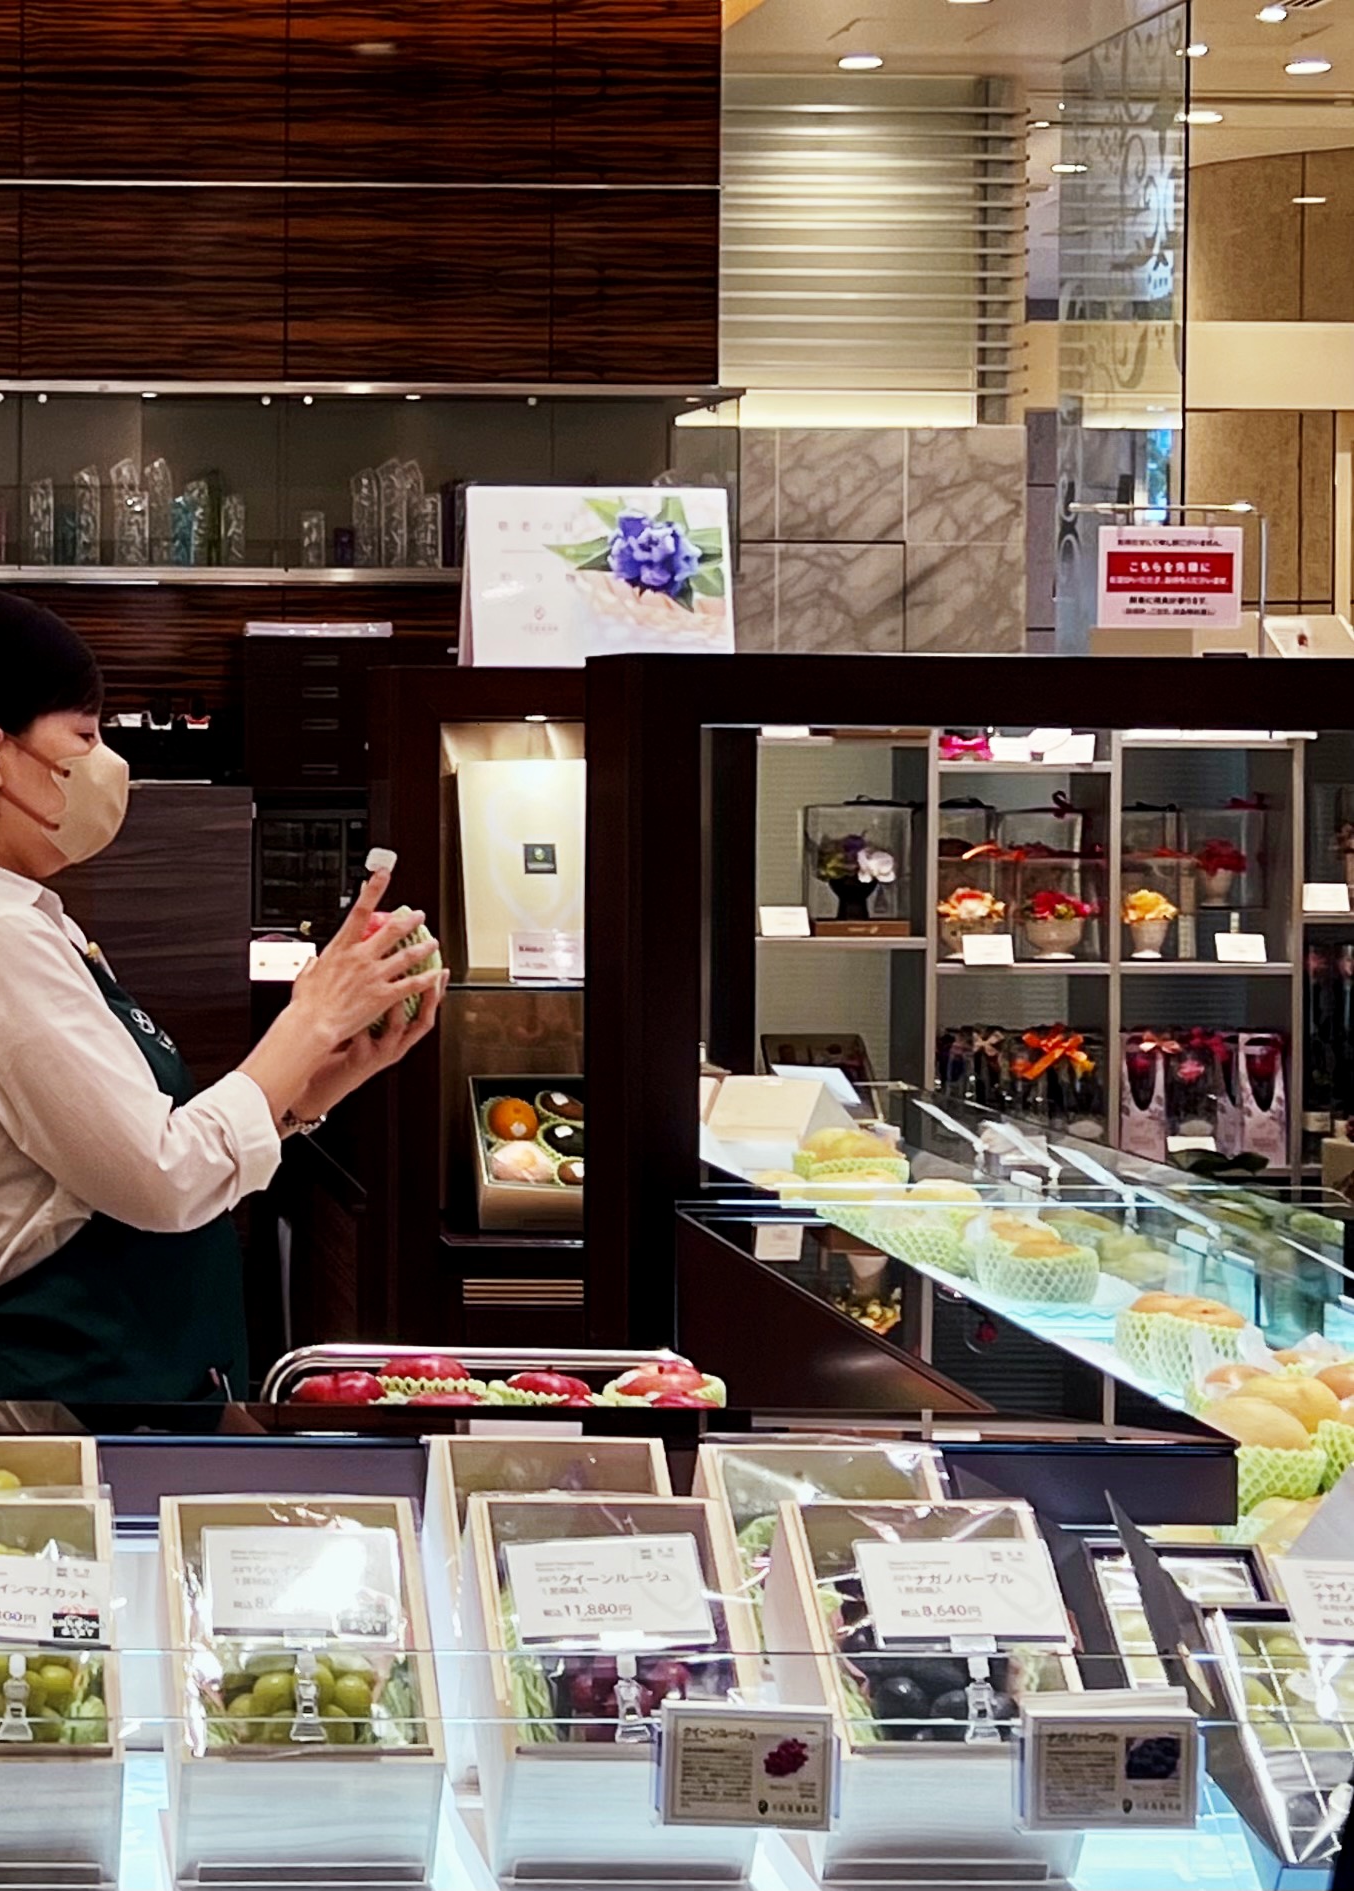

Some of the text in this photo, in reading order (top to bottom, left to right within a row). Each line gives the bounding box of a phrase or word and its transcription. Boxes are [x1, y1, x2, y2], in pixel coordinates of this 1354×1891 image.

[560, 1570, 672, 1585] クイーンルージュ
[564, 1603, 633, 1617] 11,880円
[922, 1605, 982, 1618] 8,640円
